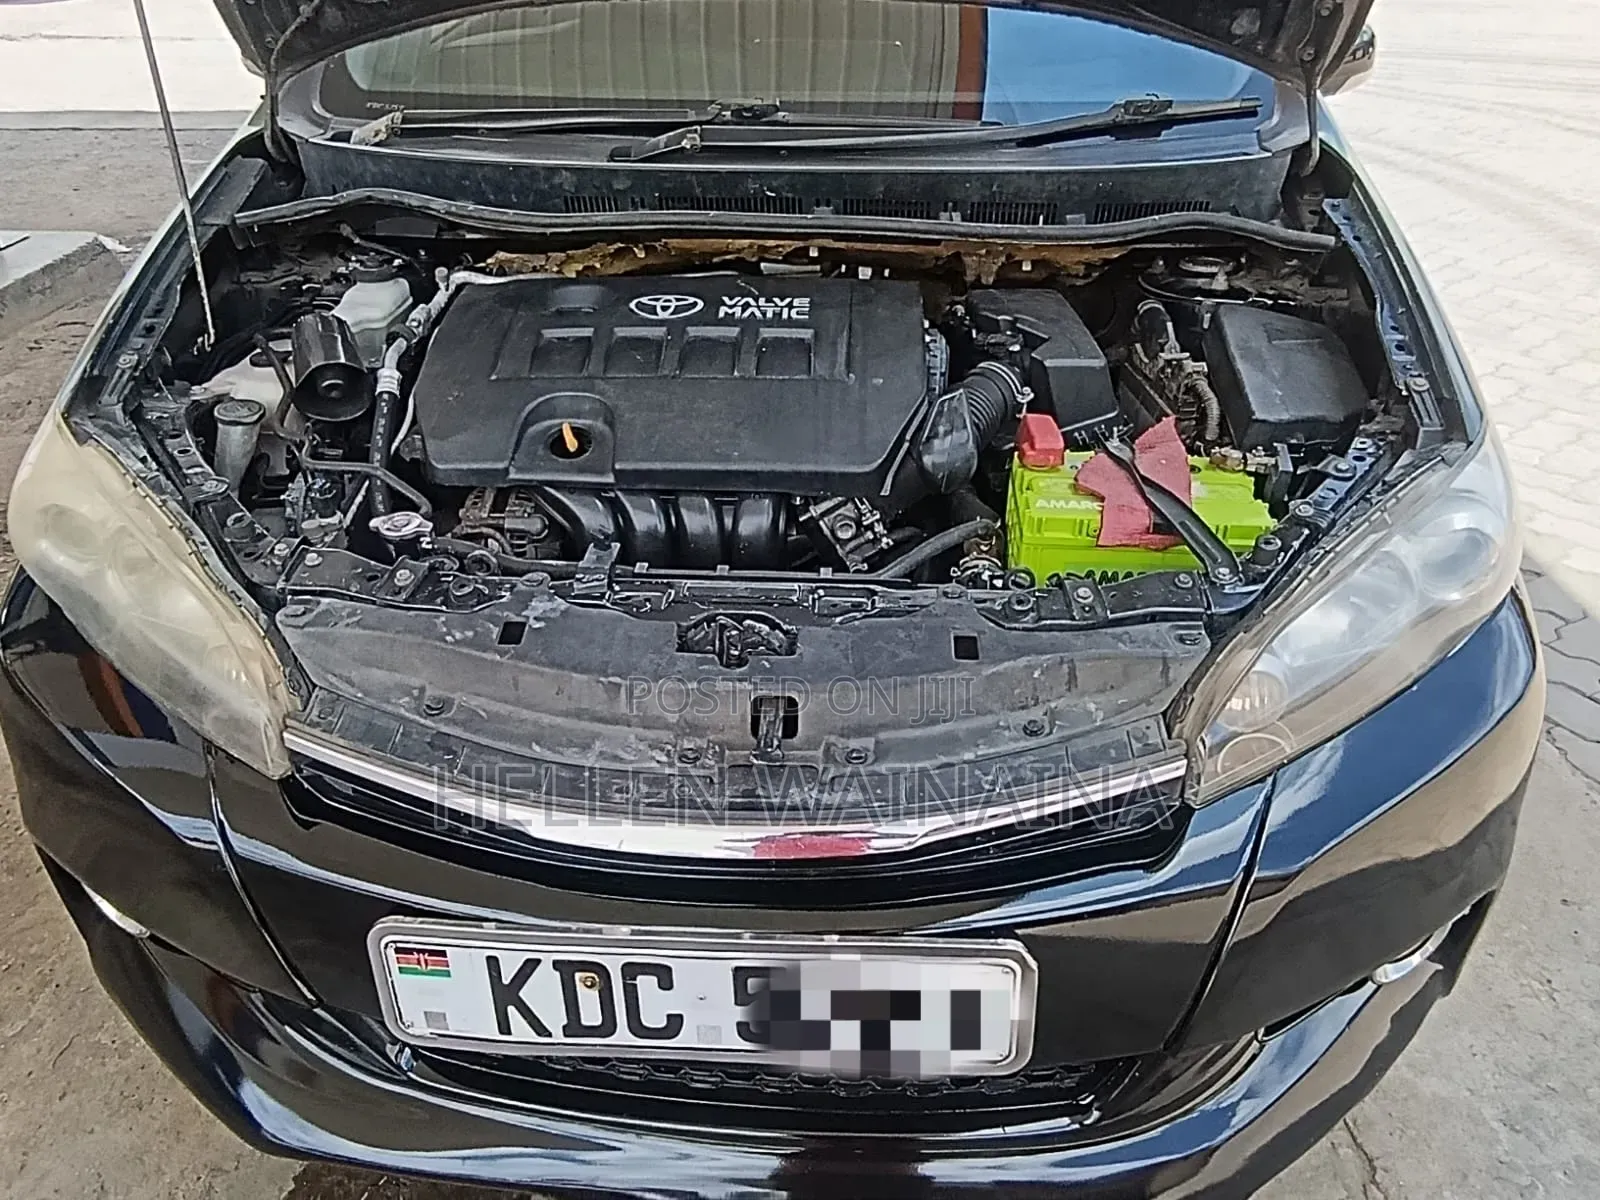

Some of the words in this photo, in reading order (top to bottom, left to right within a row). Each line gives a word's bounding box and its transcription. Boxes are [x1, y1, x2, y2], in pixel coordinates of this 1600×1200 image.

[721, 296, 810, 307] VALVE
[718, 306, 809, 319] MATIC
[486, 955, 684, 1040] KDC
